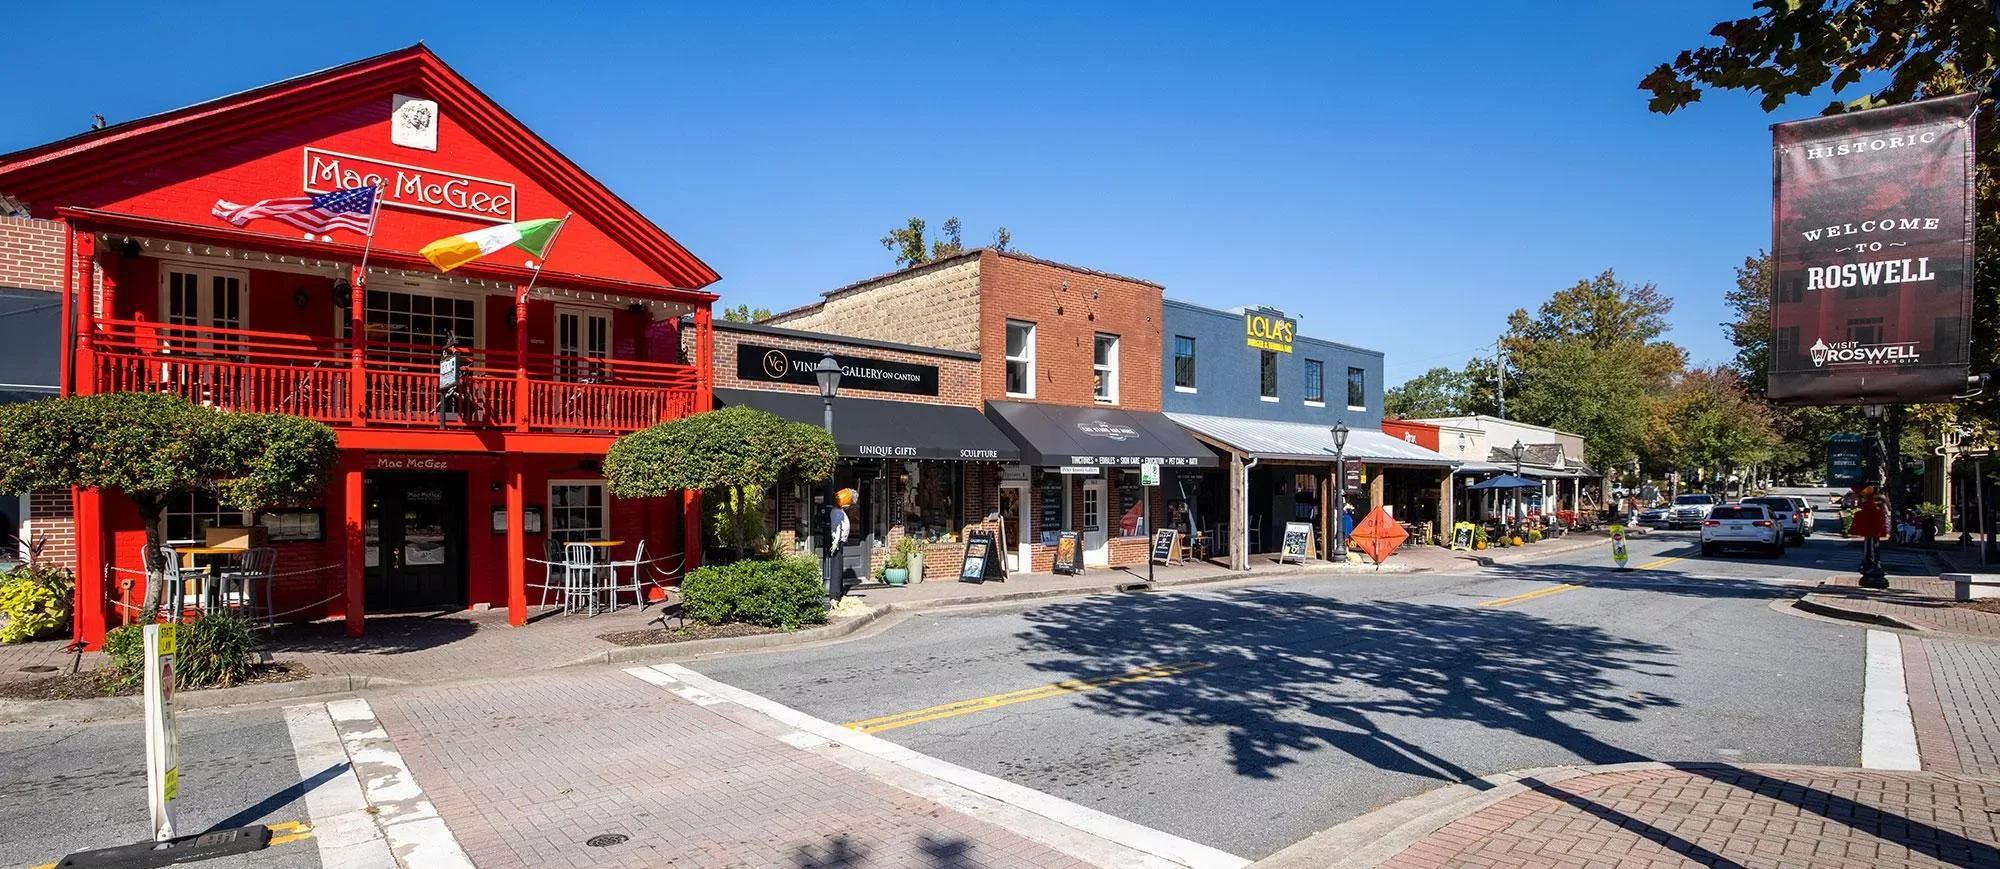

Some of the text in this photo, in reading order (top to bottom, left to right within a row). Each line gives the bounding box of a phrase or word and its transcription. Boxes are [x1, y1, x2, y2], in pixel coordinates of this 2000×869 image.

[1807, 132, 1935, 160] HISTORIC
[309, 156, 510, 215] Mac McGee
[1802, 218, 1939, 242] WELCOME
[1855, 241, 1882, 253] TO
[1807, 257, 1935, 291] ROSWELL
[1247, 315, 1292, 343] LOLA'S
[1828, 341, 1859, 349] VISIT
[1827, 345, 1920, 362] ROSWELL
[768, 355, 784, 372] VG
[841, 366, 884, 380] GALLERY
[894, 372, 921, 382] CANTON
[859, 445, 917, 457] UNIQUE GIFTS
[960, 449, 998, 458] SCULPTURE
[377, 458, 448, 469] Mac McGee
[1071, 456, 1094, 465] TINCTURES
[1099, 456, 1116, 465] EDIBLES
[1120, 456, 1130, 465] SKIN
[1130, 457, 1141, 465] CARE
[1144, 457, 1164, 465] EDUCATION
[1168, 457, 1176, 465] PET
[1176, 457, 1185, 465] CARE
[161, 626, 173, 638] STATE
[162, 639, 173, 651] LAW
